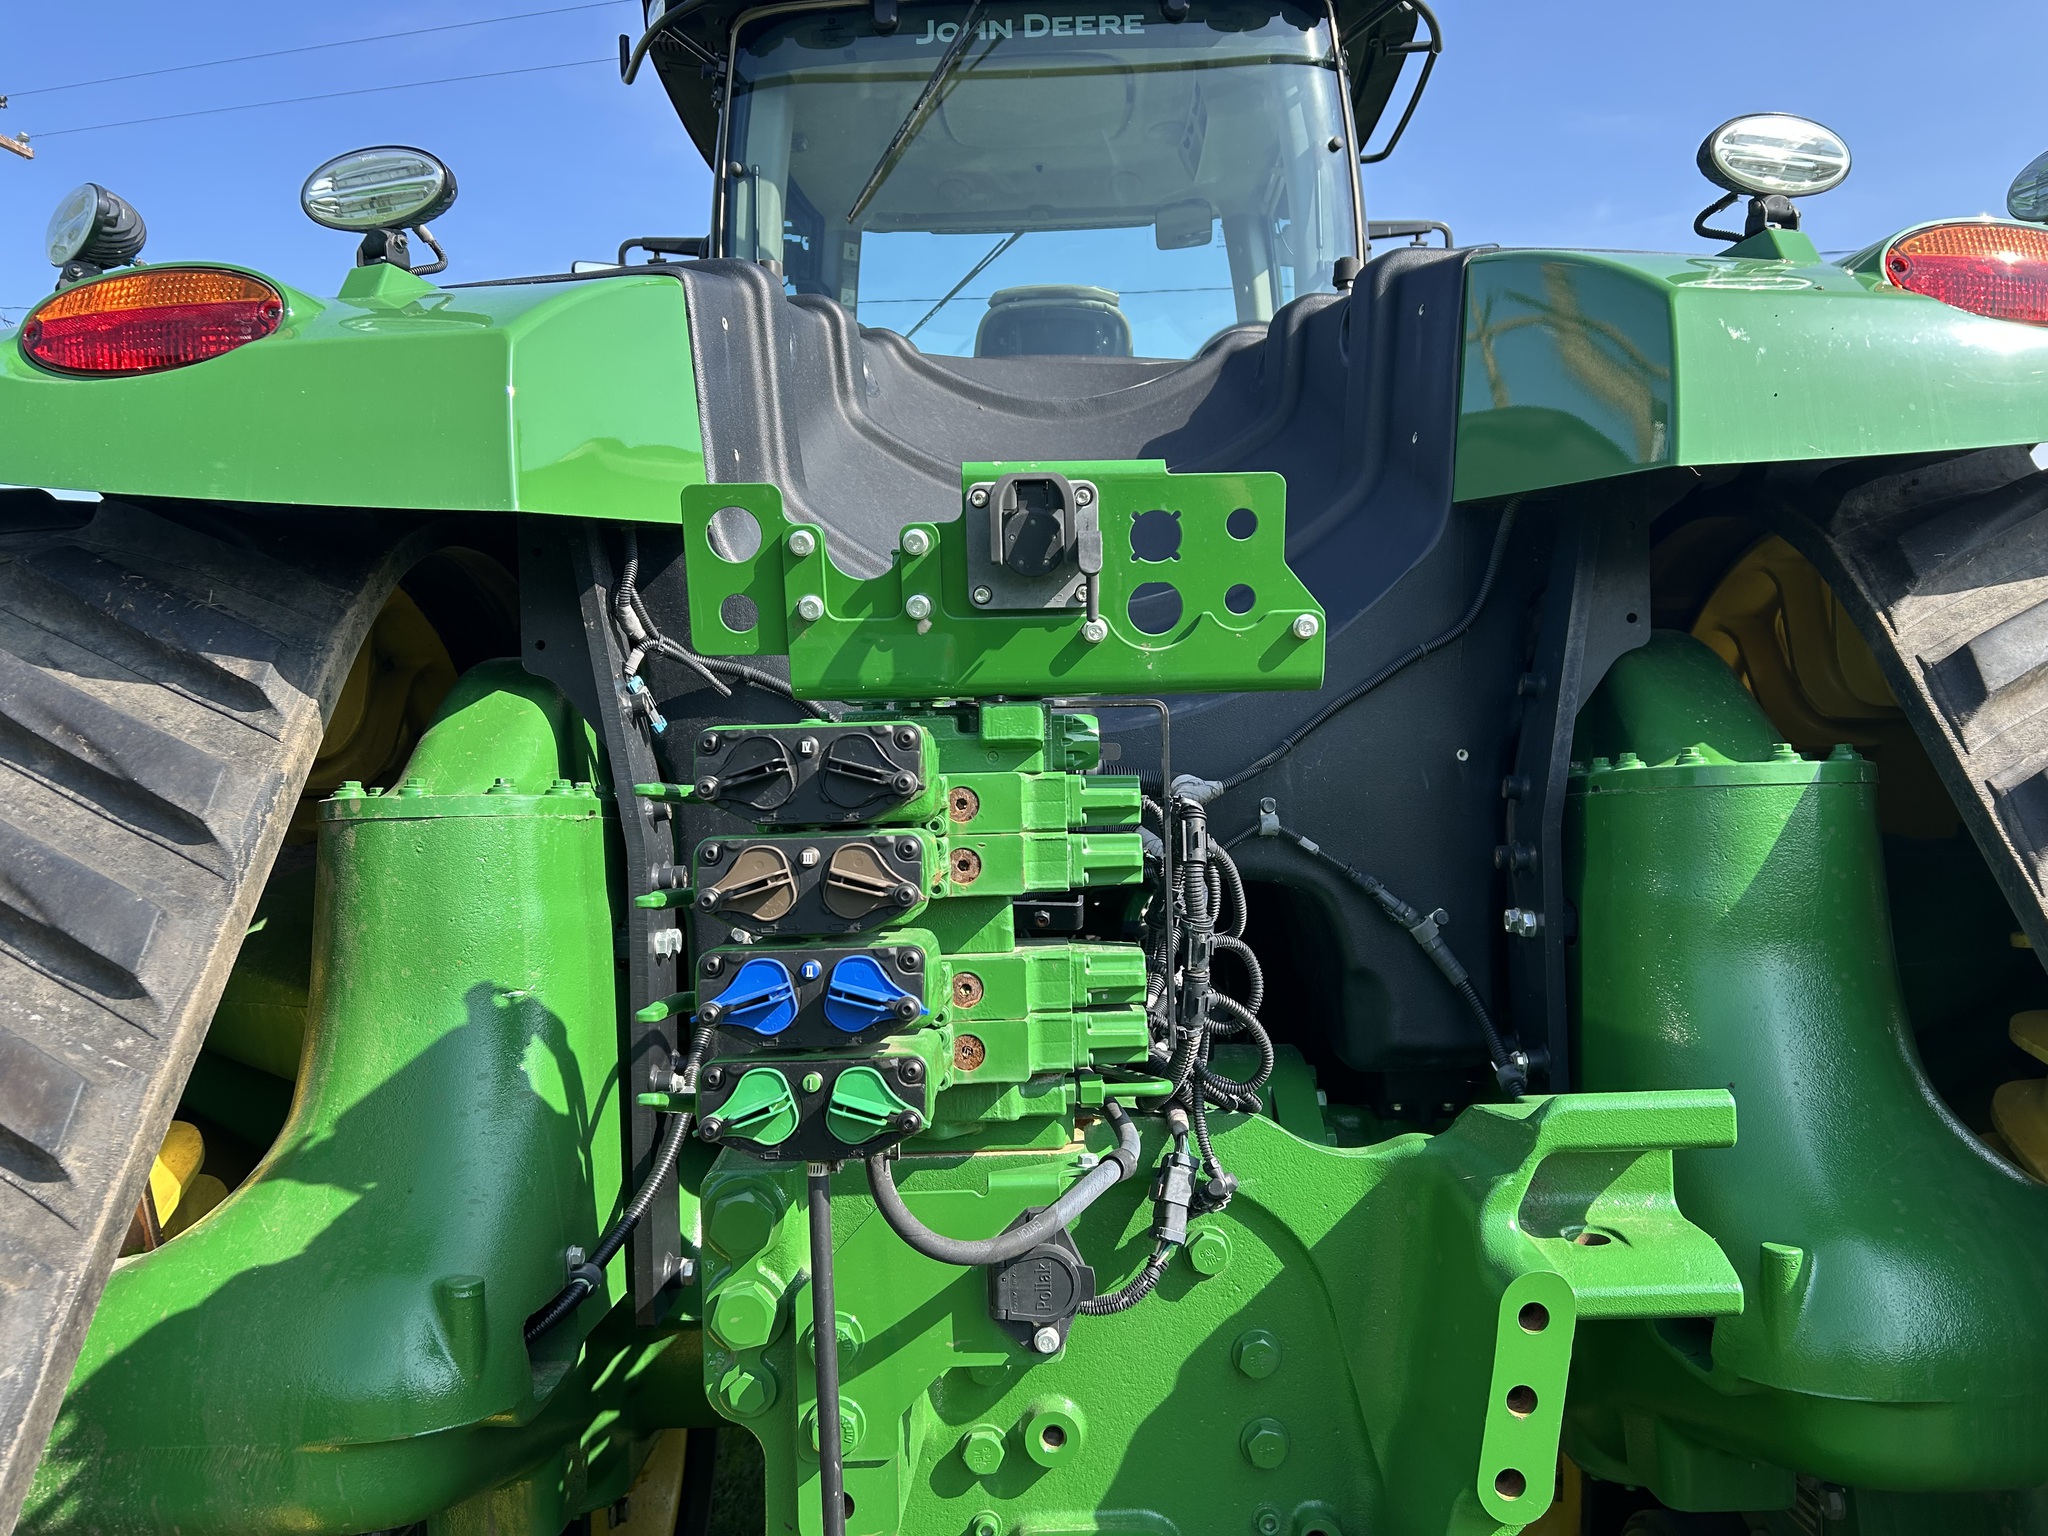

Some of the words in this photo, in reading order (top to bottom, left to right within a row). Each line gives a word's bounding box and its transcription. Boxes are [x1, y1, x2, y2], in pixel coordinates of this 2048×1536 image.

[915, 18, 1013, 45] JOHN
[1024, 13, 1146, 38] DEERE
[801, 741, 812, 753] IV
[802, 852, 814, 865] III
[805, 965, 814, 978] II
[1016, 1221, 1044, 1241] EATON
[1033, 1262, 1053, 1312] Pollak
